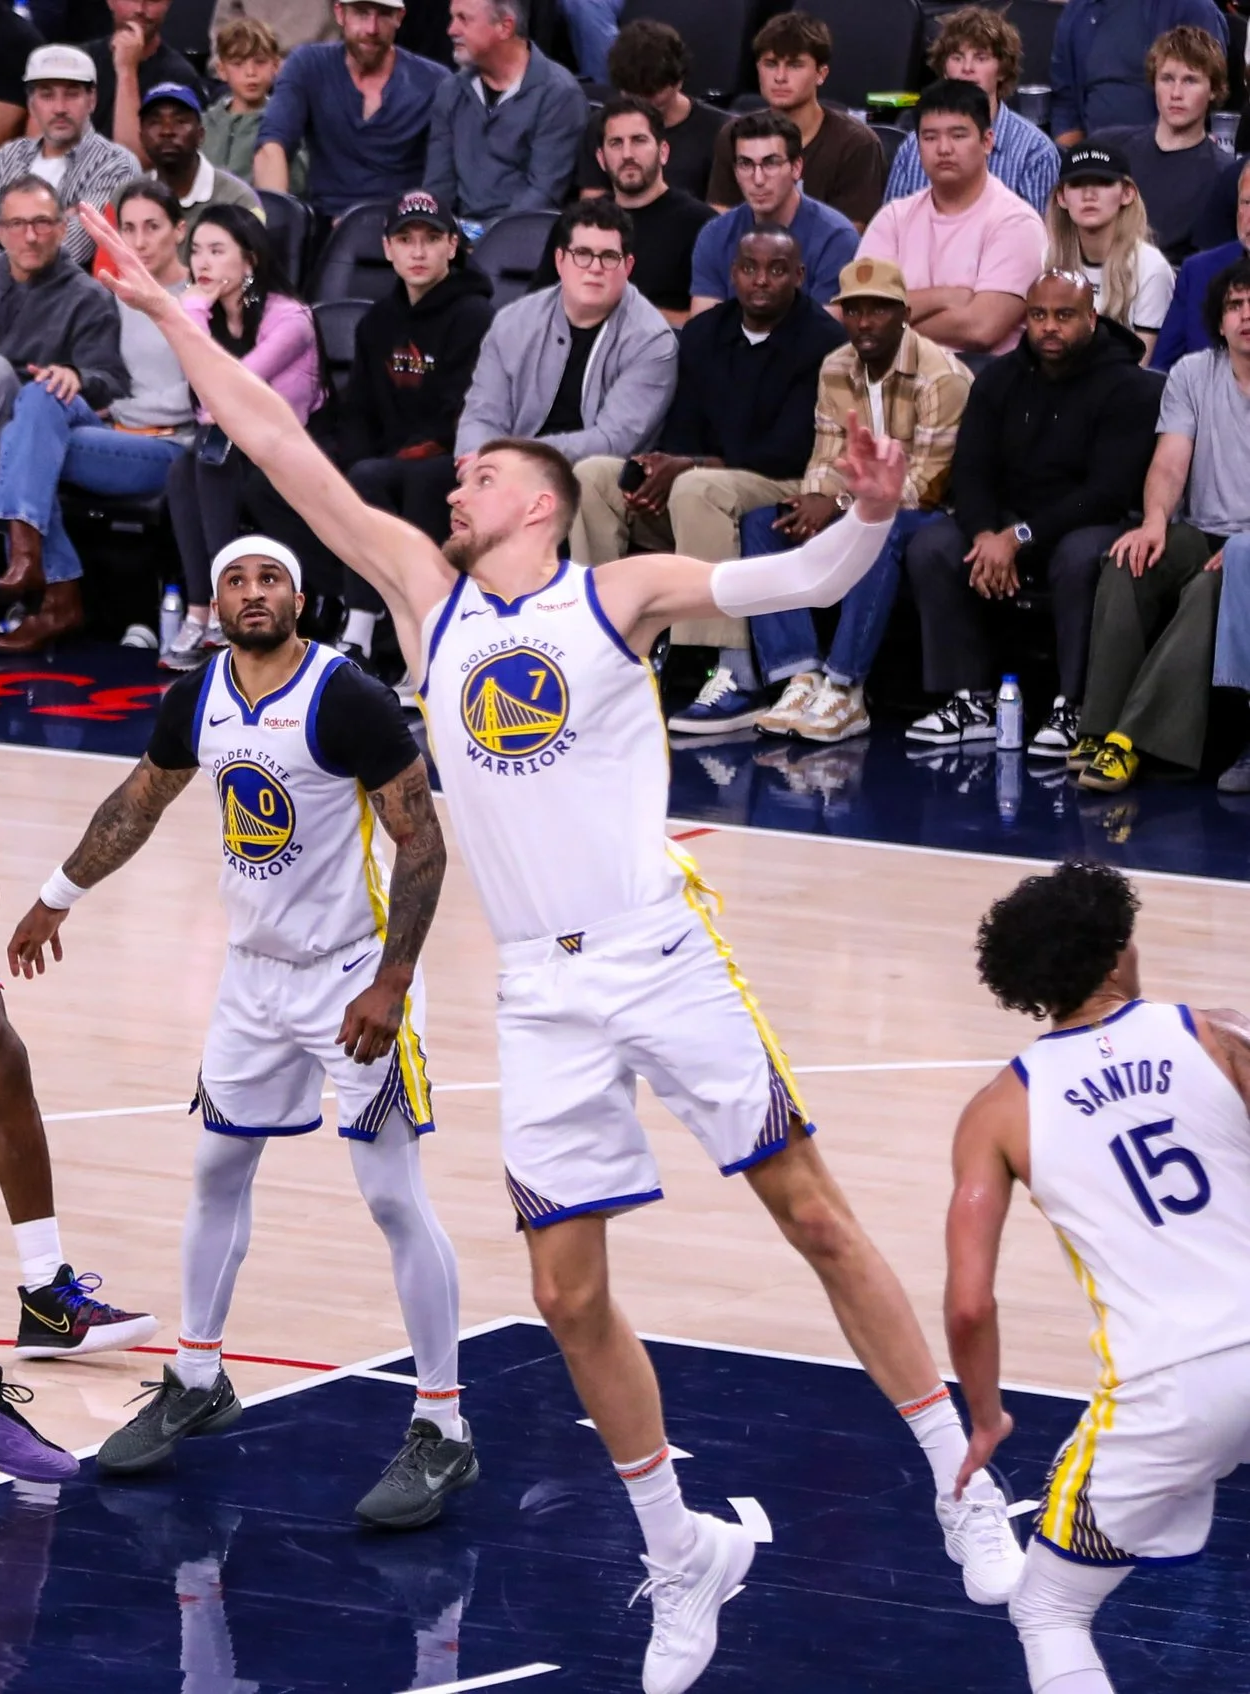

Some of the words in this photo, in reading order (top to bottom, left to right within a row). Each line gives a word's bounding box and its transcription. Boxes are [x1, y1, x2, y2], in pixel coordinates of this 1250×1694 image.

[460, 636, 517, 673] GOLDEN
[521, 636, 566, 661] STATE
[528, 670, 547, 701] 7
[263, 717, 300, 730] Rakuten
[256, 751, 291, 783] STATE
[465, 728, 578, 777] WARRIORS
[258, 788, 276, 817] 0
[1063, 1059, 1173, 1117] SANTOS
[1107, 1116, 1212, 1228] 15
